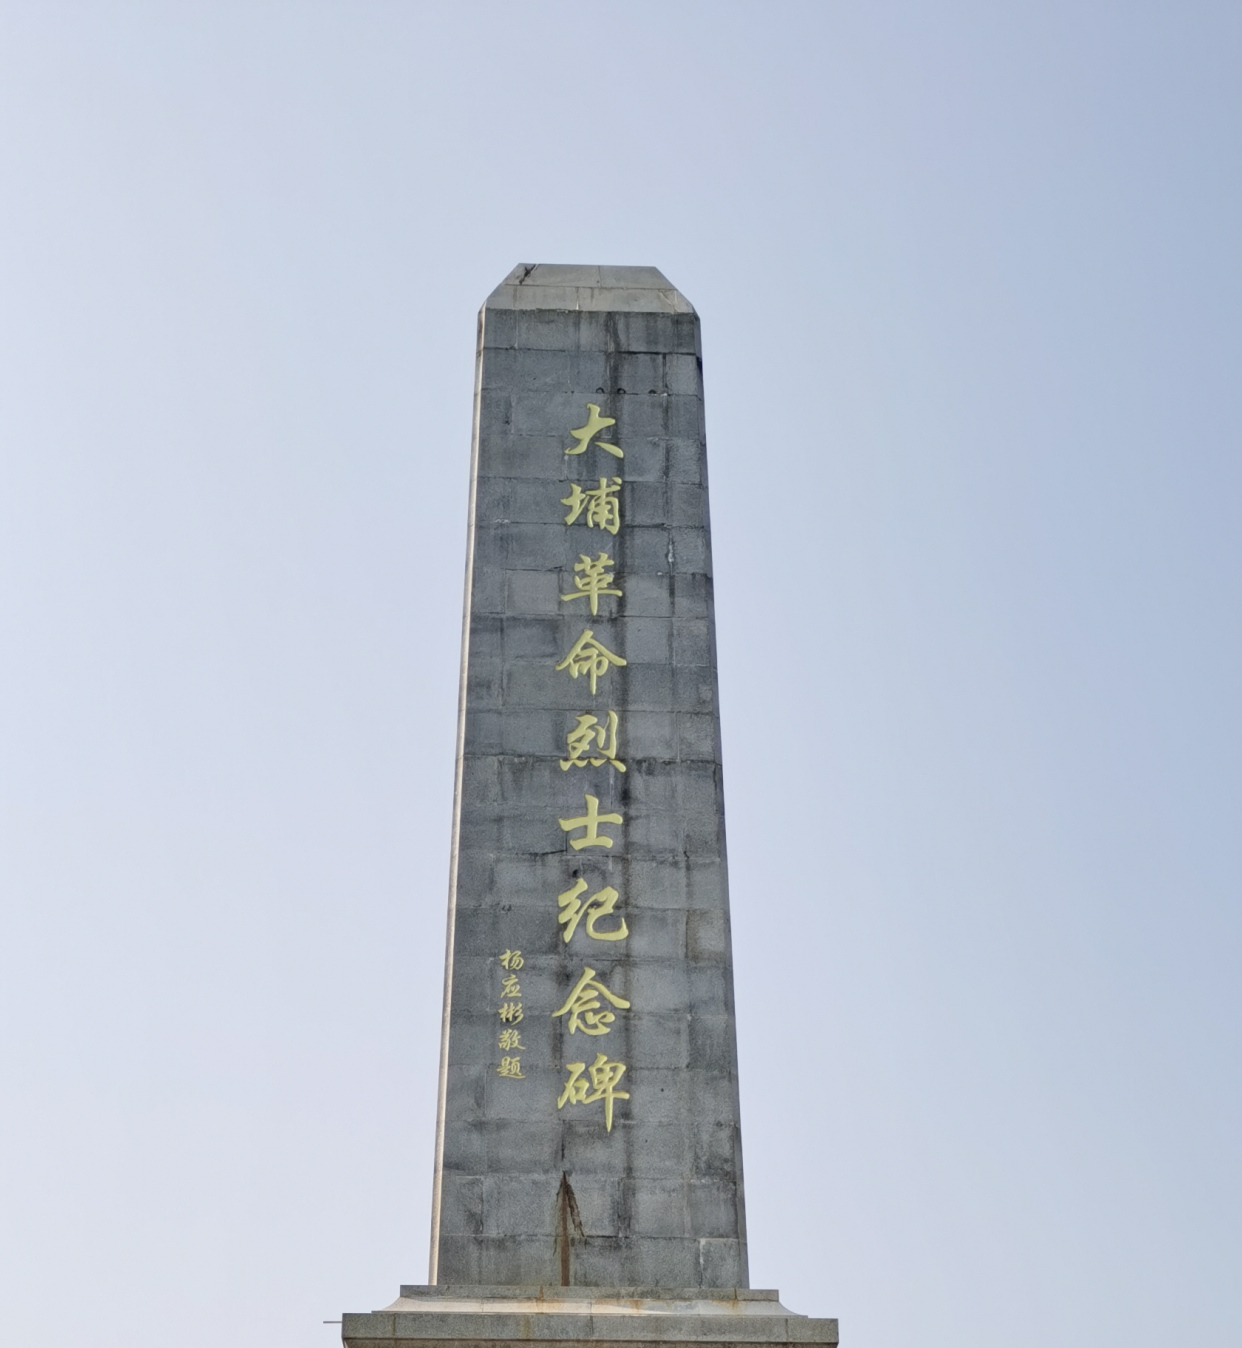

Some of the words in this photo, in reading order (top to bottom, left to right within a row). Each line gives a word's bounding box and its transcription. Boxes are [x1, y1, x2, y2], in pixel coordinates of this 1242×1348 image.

[553, 403, 631, 1131] 大埔革命烈士纪念碑
[496, 949, 526, 1079] 杨应彬敬题
